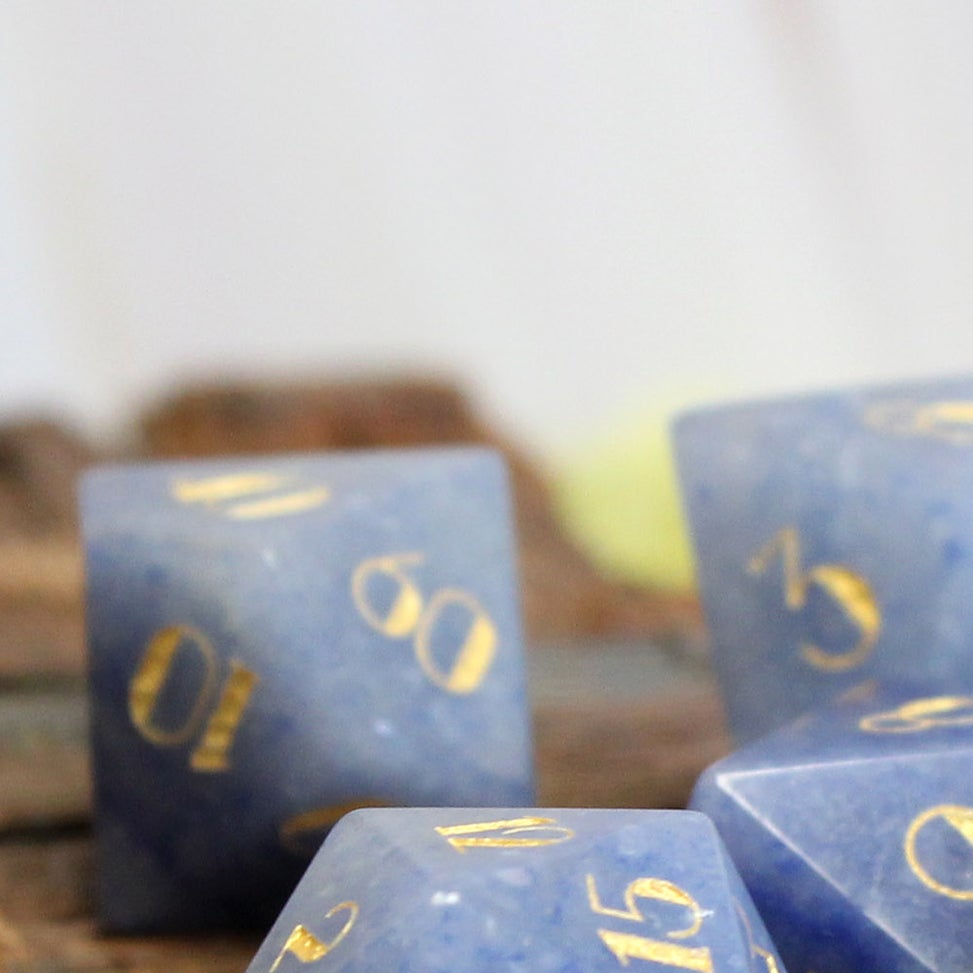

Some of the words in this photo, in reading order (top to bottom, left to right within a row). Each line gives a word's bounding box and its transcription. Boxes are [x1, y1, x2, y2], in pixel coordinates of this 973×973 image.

[351, 552, 497, 693] 60
[746, 526, 881, 673] 3
[269, 901, 361, 973] 2
